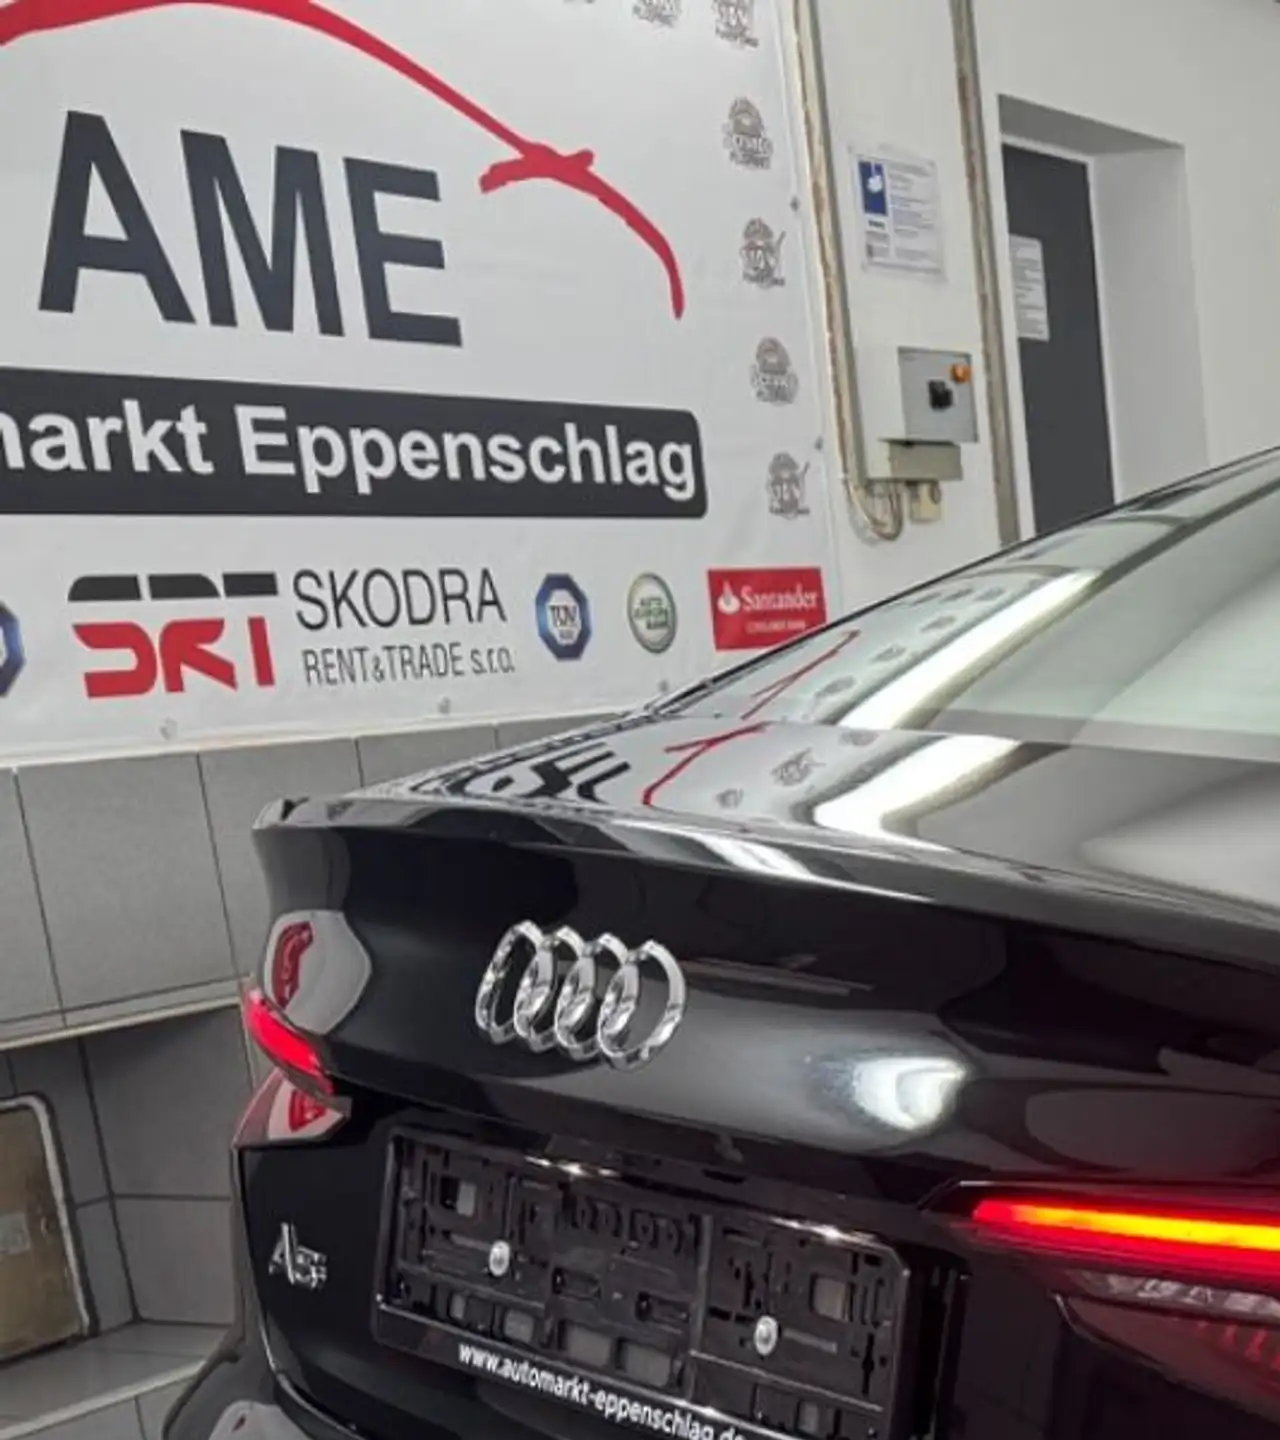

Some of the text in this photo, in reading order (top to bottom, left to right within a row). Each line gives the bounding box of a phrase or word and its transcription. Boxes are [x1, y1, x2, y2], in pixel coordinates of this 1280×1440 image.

[38, 109, 463, 348] AME
[234, 404, 695, 502] Eppenschlag
[293, 567, 507, 632] SKODRA
